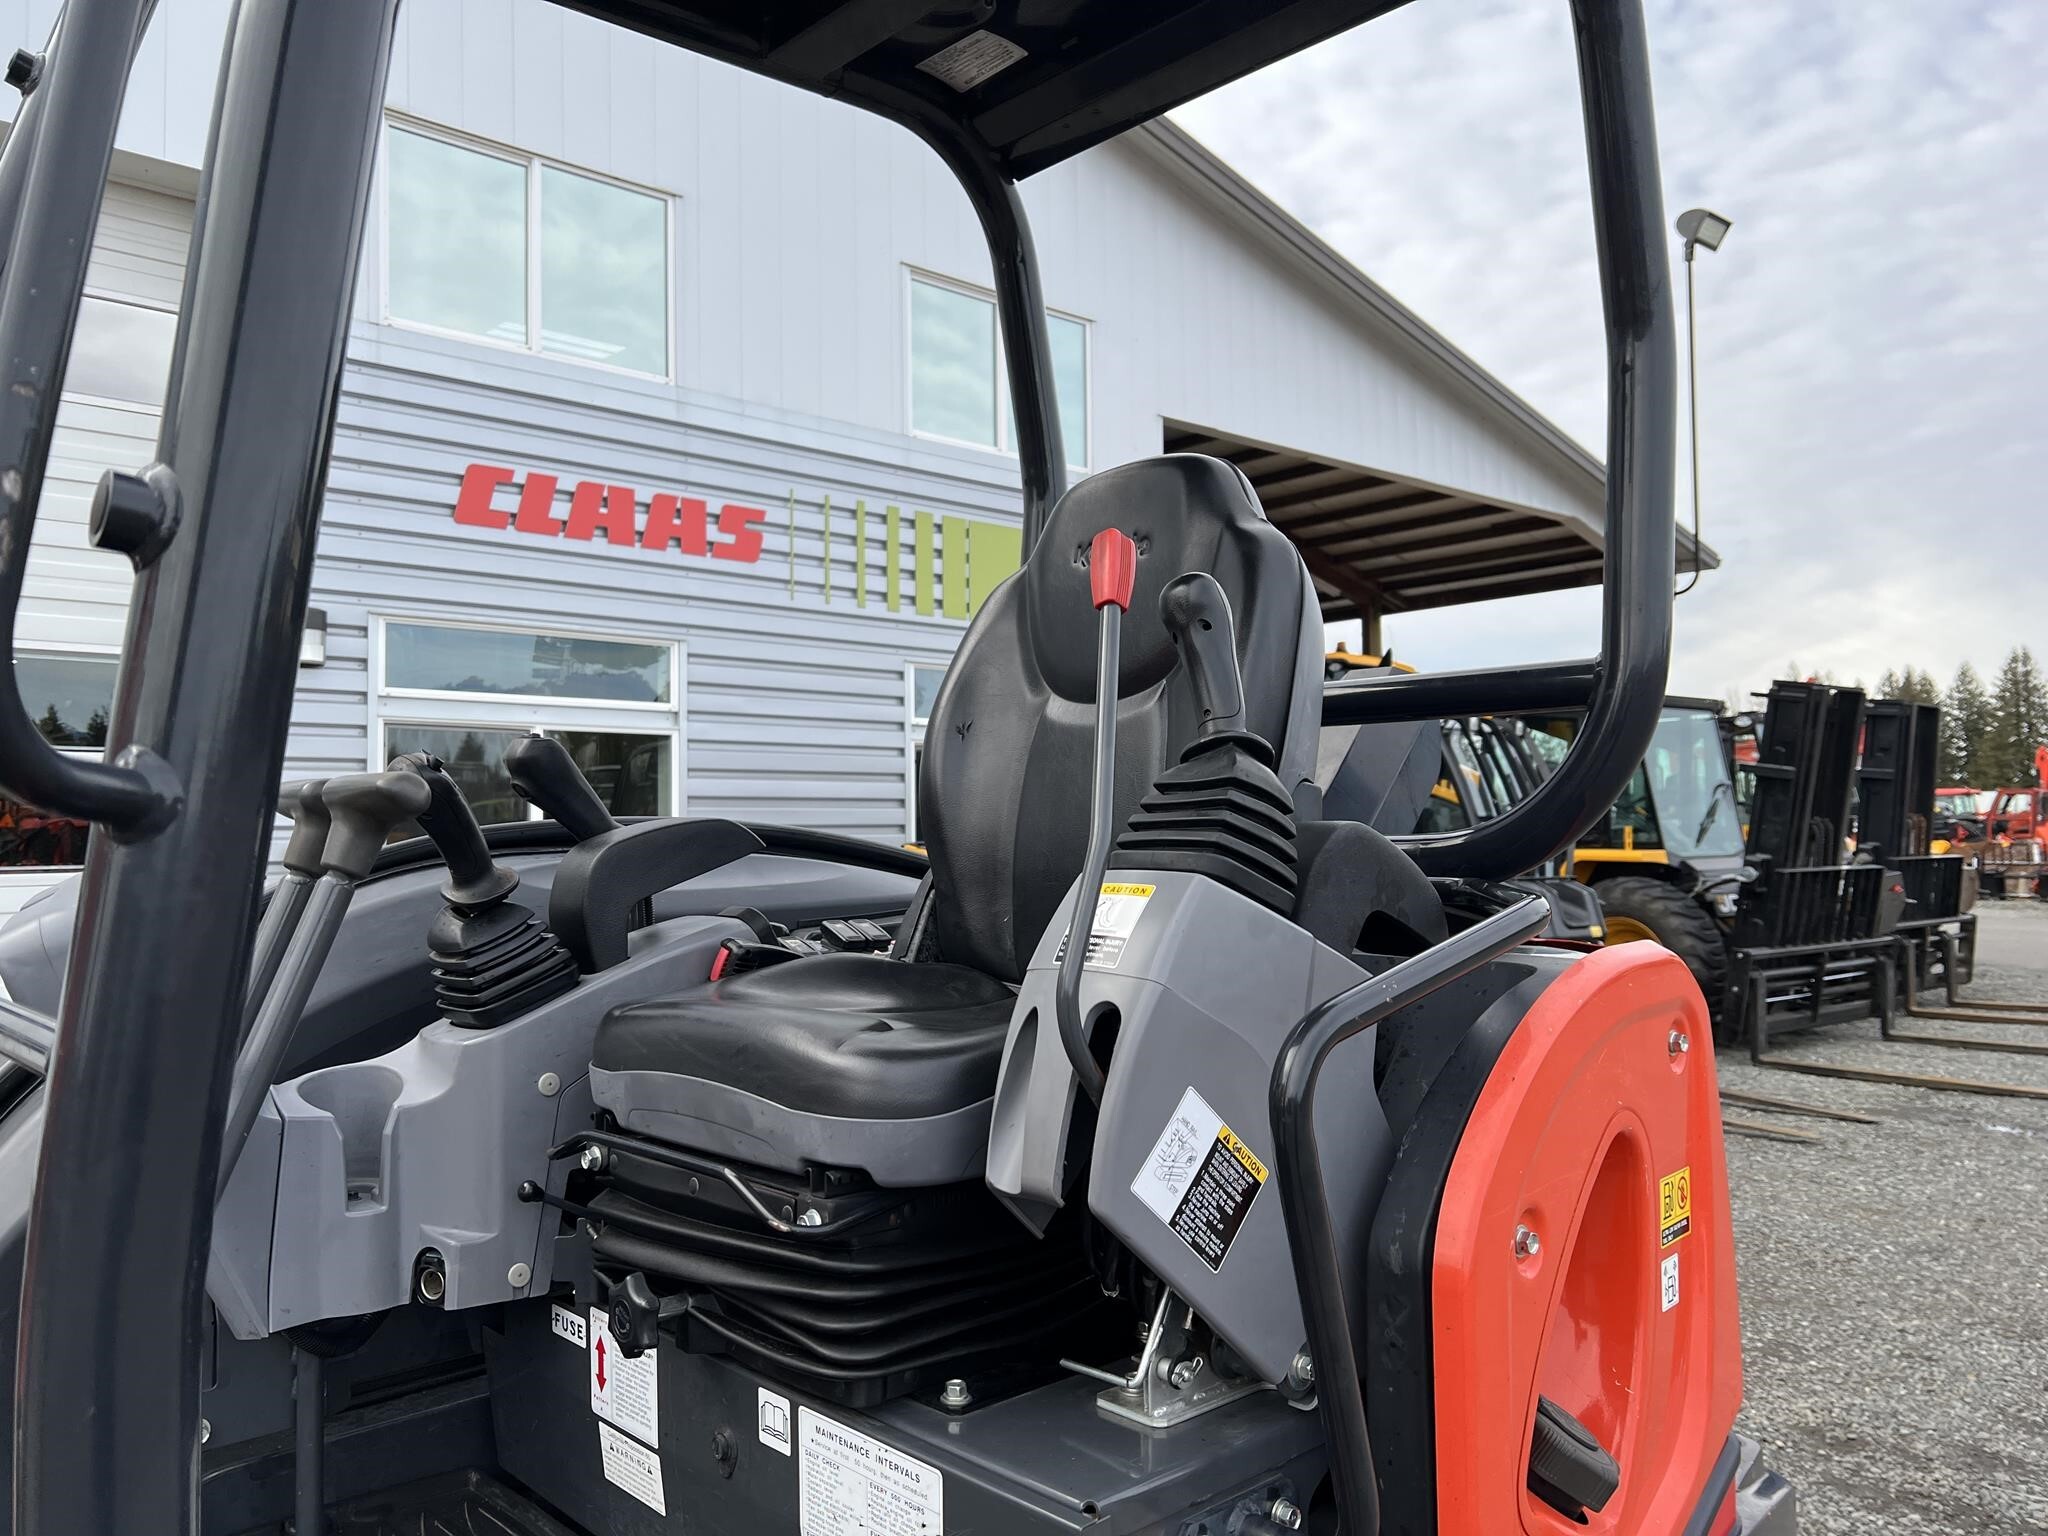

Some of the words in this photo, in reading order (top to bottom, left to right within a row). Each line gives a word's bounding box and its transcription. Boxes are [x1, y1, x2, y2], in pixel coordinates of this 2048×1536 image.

[453, 464, 767, 563] CLAAS
[1103, 886, 1147, 895] CAUTION
[1719, 894, 1739, 913] JC
[1232, 1142, 1262, 1175] CAUTION
[555, 1312, 584, 1340] FUSE
[616, 1448, 647, 1471] WARNING
[804, 1449, 819, 1461] DAILY
[822, 1457, 840, 1472] CHECK
[815, 1425, 870, 1459] MAINTENANCE
[875, 1454, 921, 1484] INTERVALS
[869, 1482, 887, 1495] EVERY
[904, 1501, 925, 1516] HOURS
